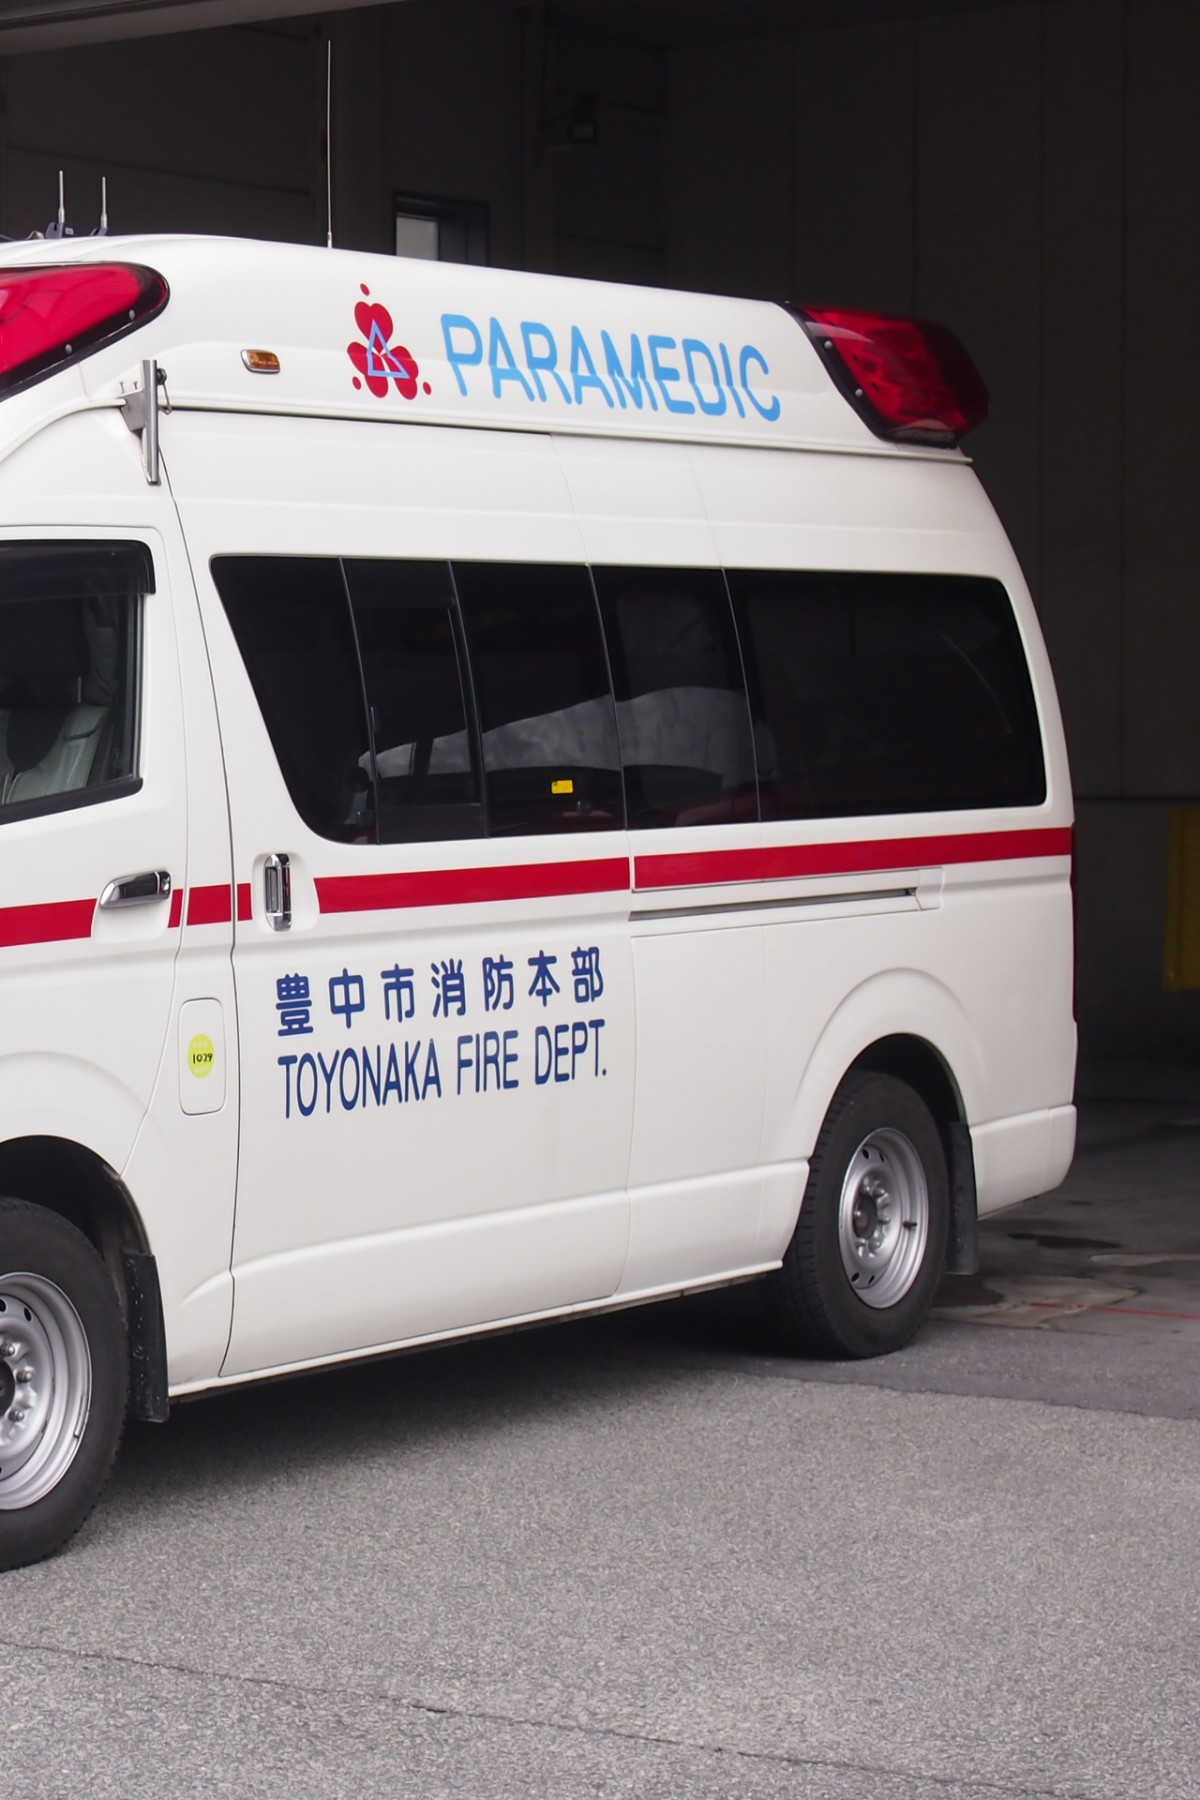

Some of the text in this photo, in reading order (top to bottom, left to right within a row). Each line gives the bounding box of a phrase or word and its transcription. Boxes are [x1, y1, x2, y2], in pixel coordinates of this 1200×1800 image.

[440, 313, 781, 422] PARAMEDIC
[275, 946, 605, 1037] 豊中市消防本部
[277, 1019, 607, 1119] TOYONAKA FIRE DEPT.
